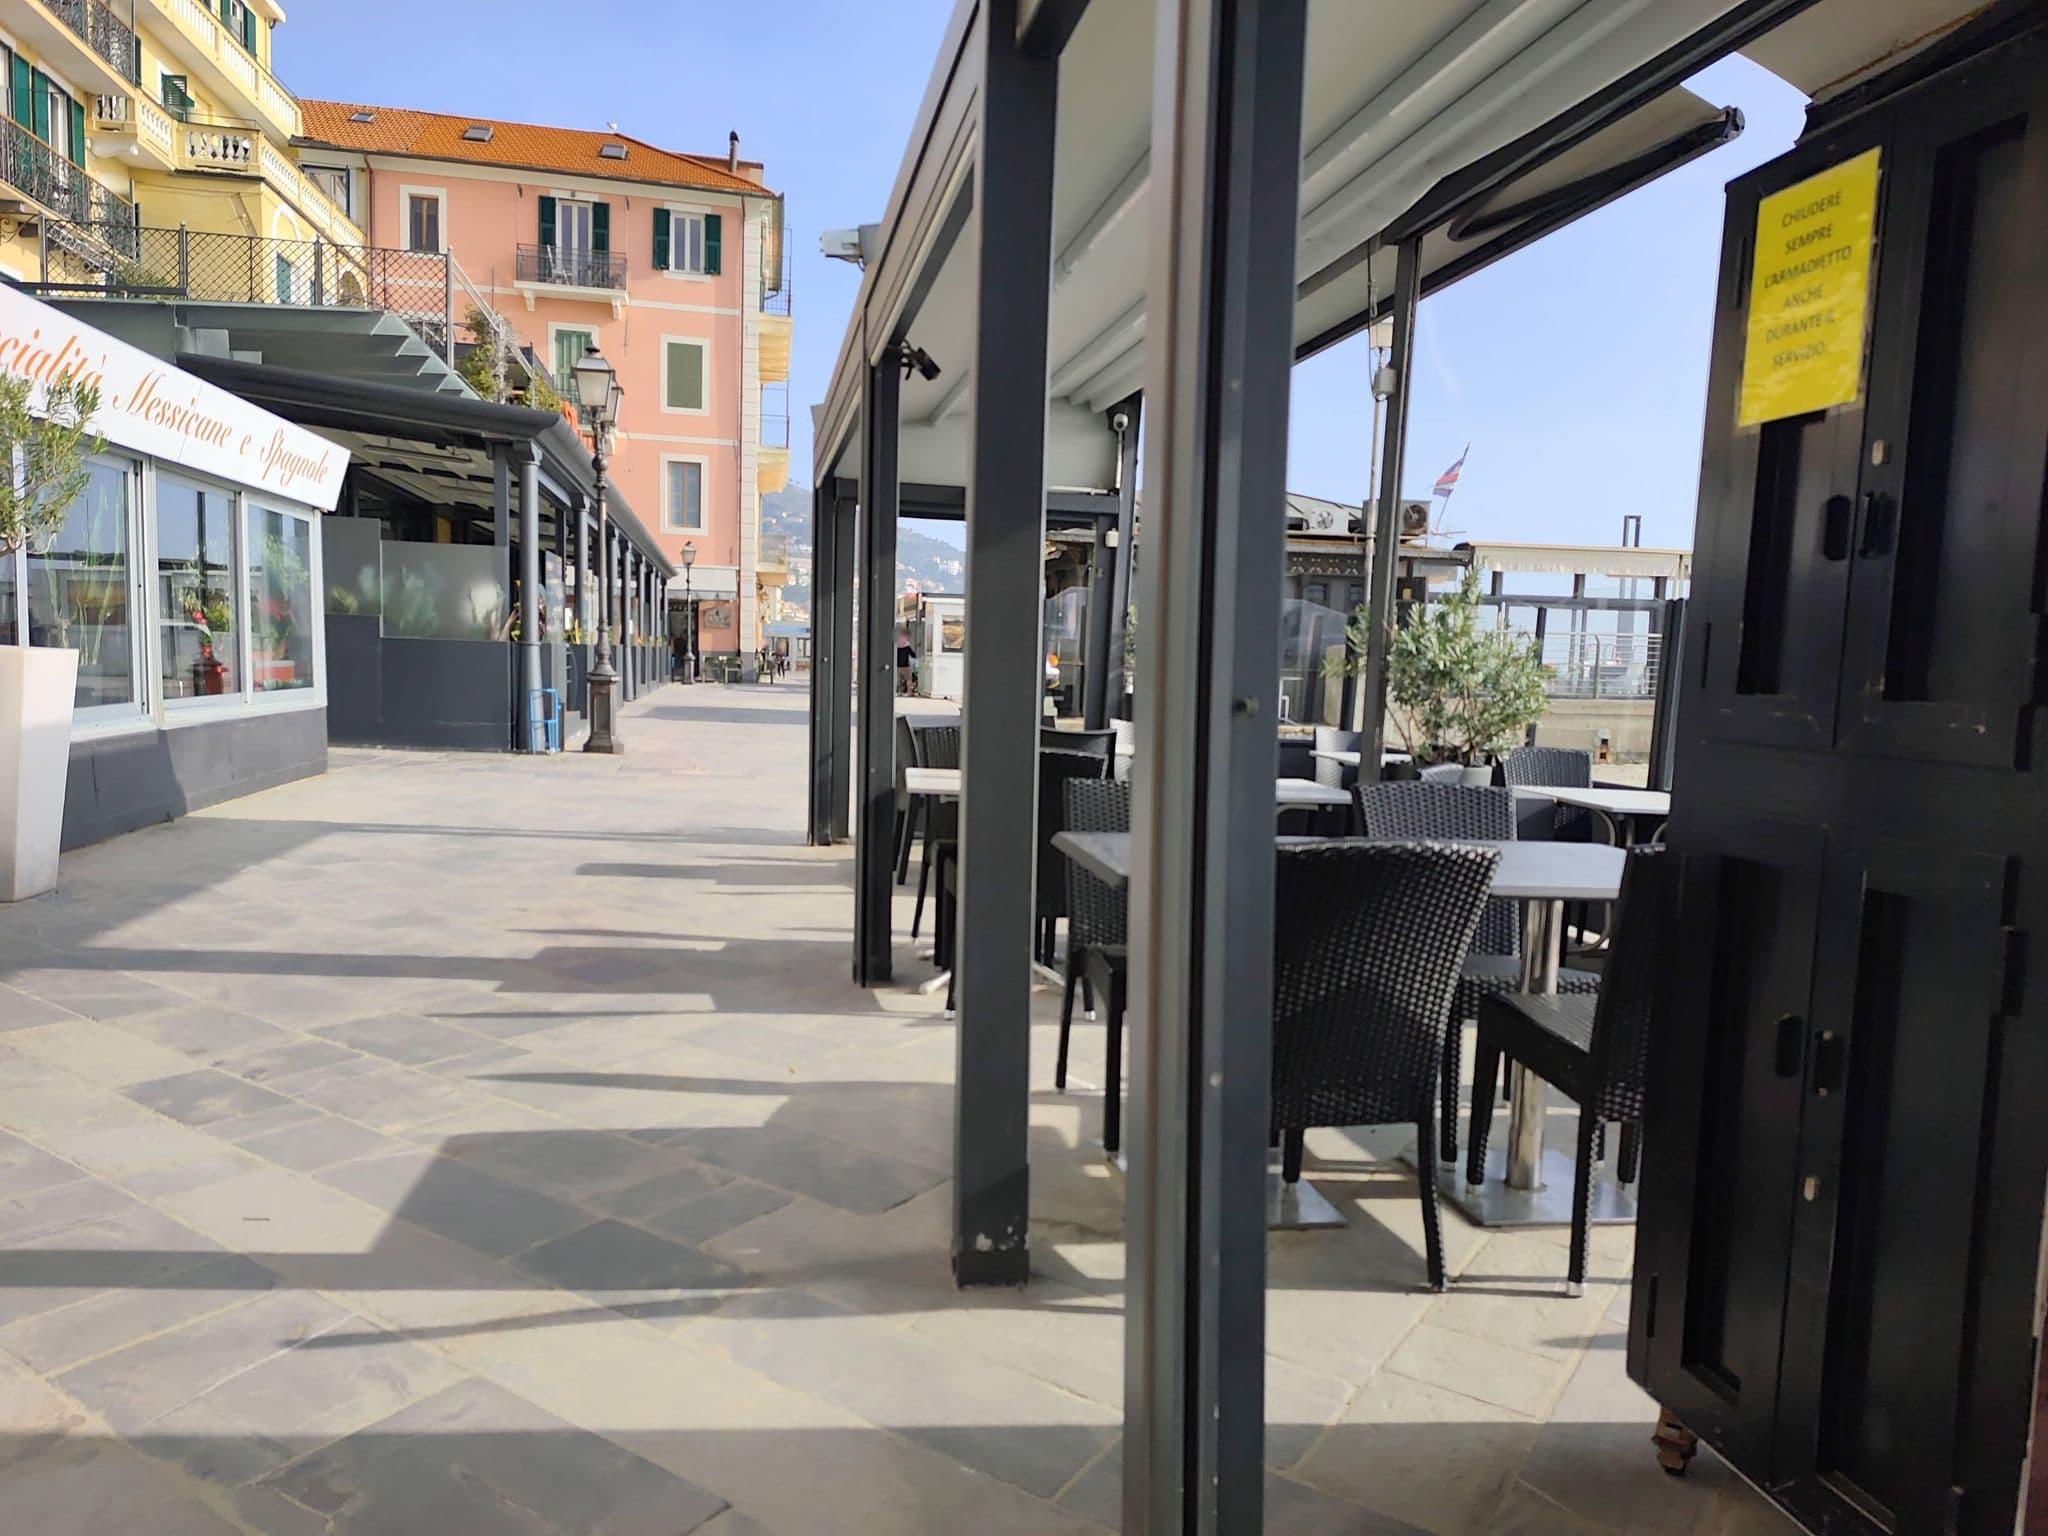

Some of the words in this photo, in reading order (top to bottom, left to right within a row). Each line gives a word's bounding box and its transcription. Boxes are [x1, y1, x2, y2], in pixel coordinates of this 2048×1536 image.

[1782, 190, 1843, 228] CHIUDERE
[1784, 222, 1834, 255] SEMPRE
[1782, 283, 1824, 312] ANCHE
[1765, 312, 1822, 344] DURANTE
[1772, 340, 1825, 369] SERVIZIO
[112, 369, 233, 448] Messicane
[239, 433, 252, 455] e
[259, 426, 329, 487] Spagnole
